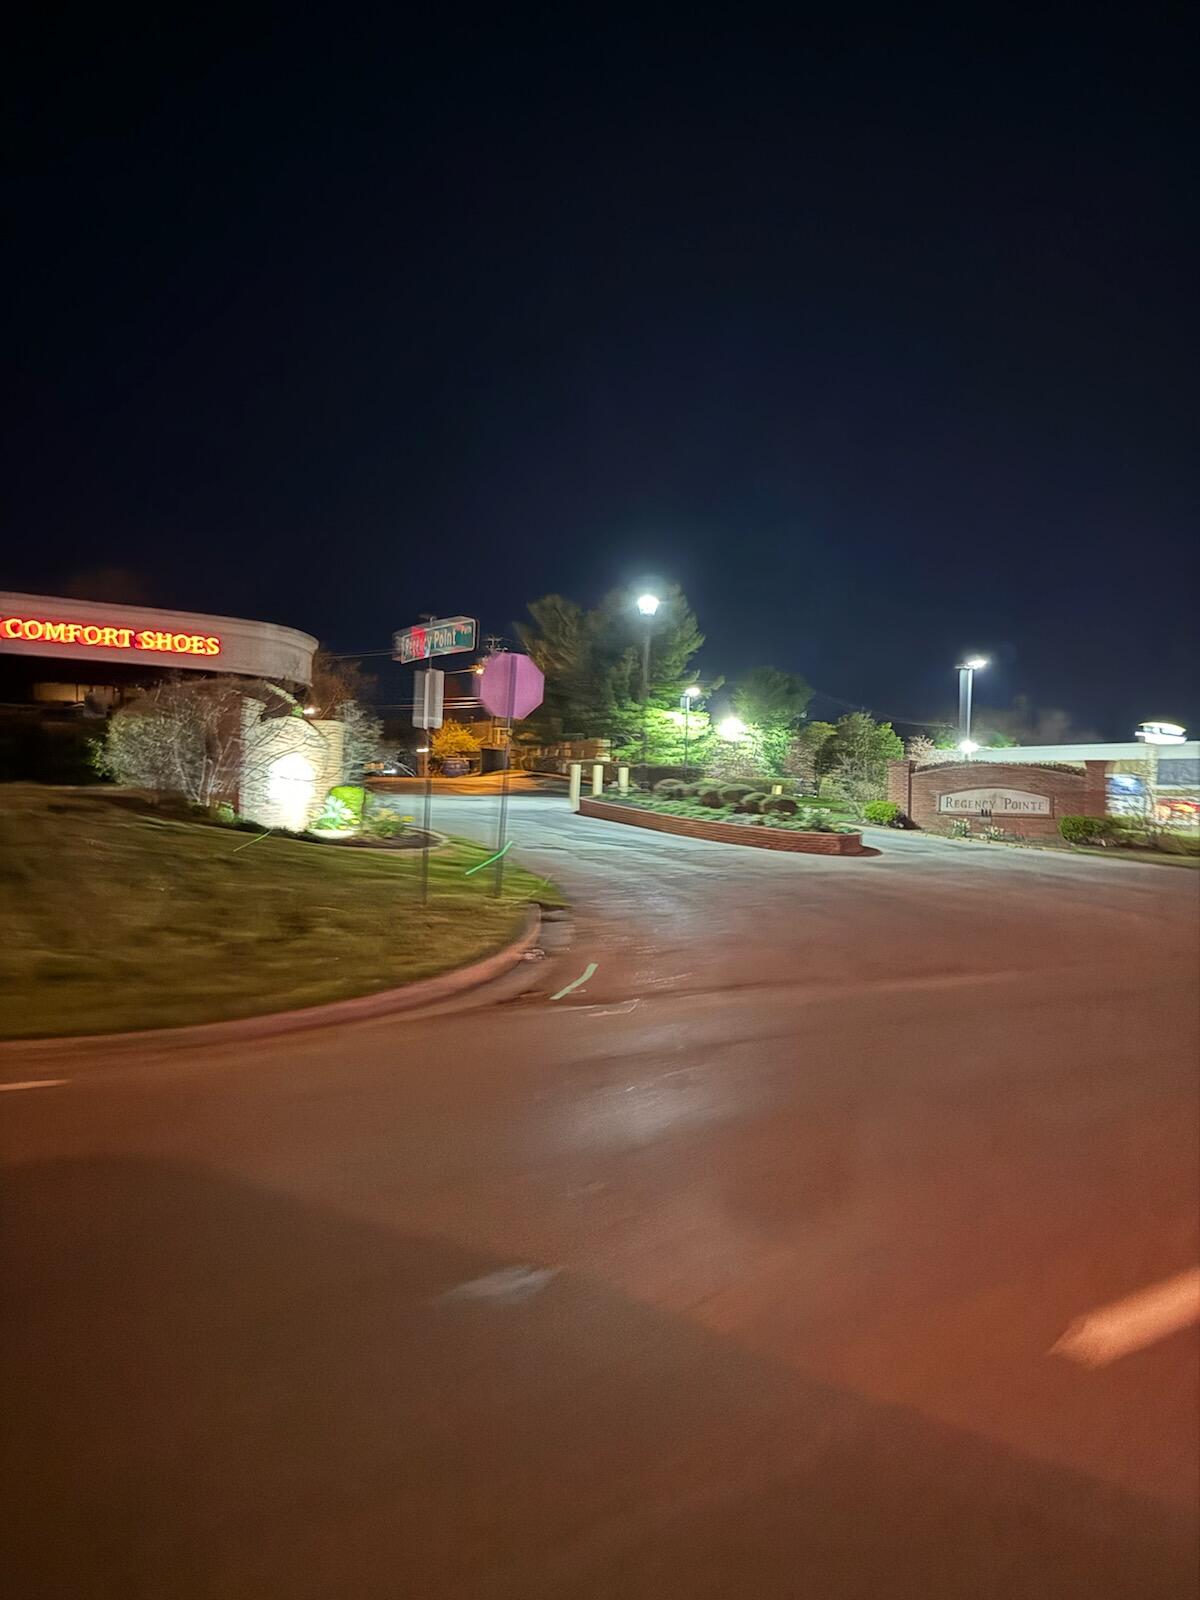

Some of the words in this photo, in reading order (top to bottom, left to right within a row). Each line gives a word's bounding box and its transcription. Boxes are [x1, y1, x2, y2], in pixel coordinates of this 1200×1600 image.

[3, 618, 134, 648] COMFORT
[137, 631, 220, 656] SHOES
[433, 628, 457, 649] Point
[945, 796, 997, 810] REGENCY
[1003, 797, 1045, 811] POINTE
